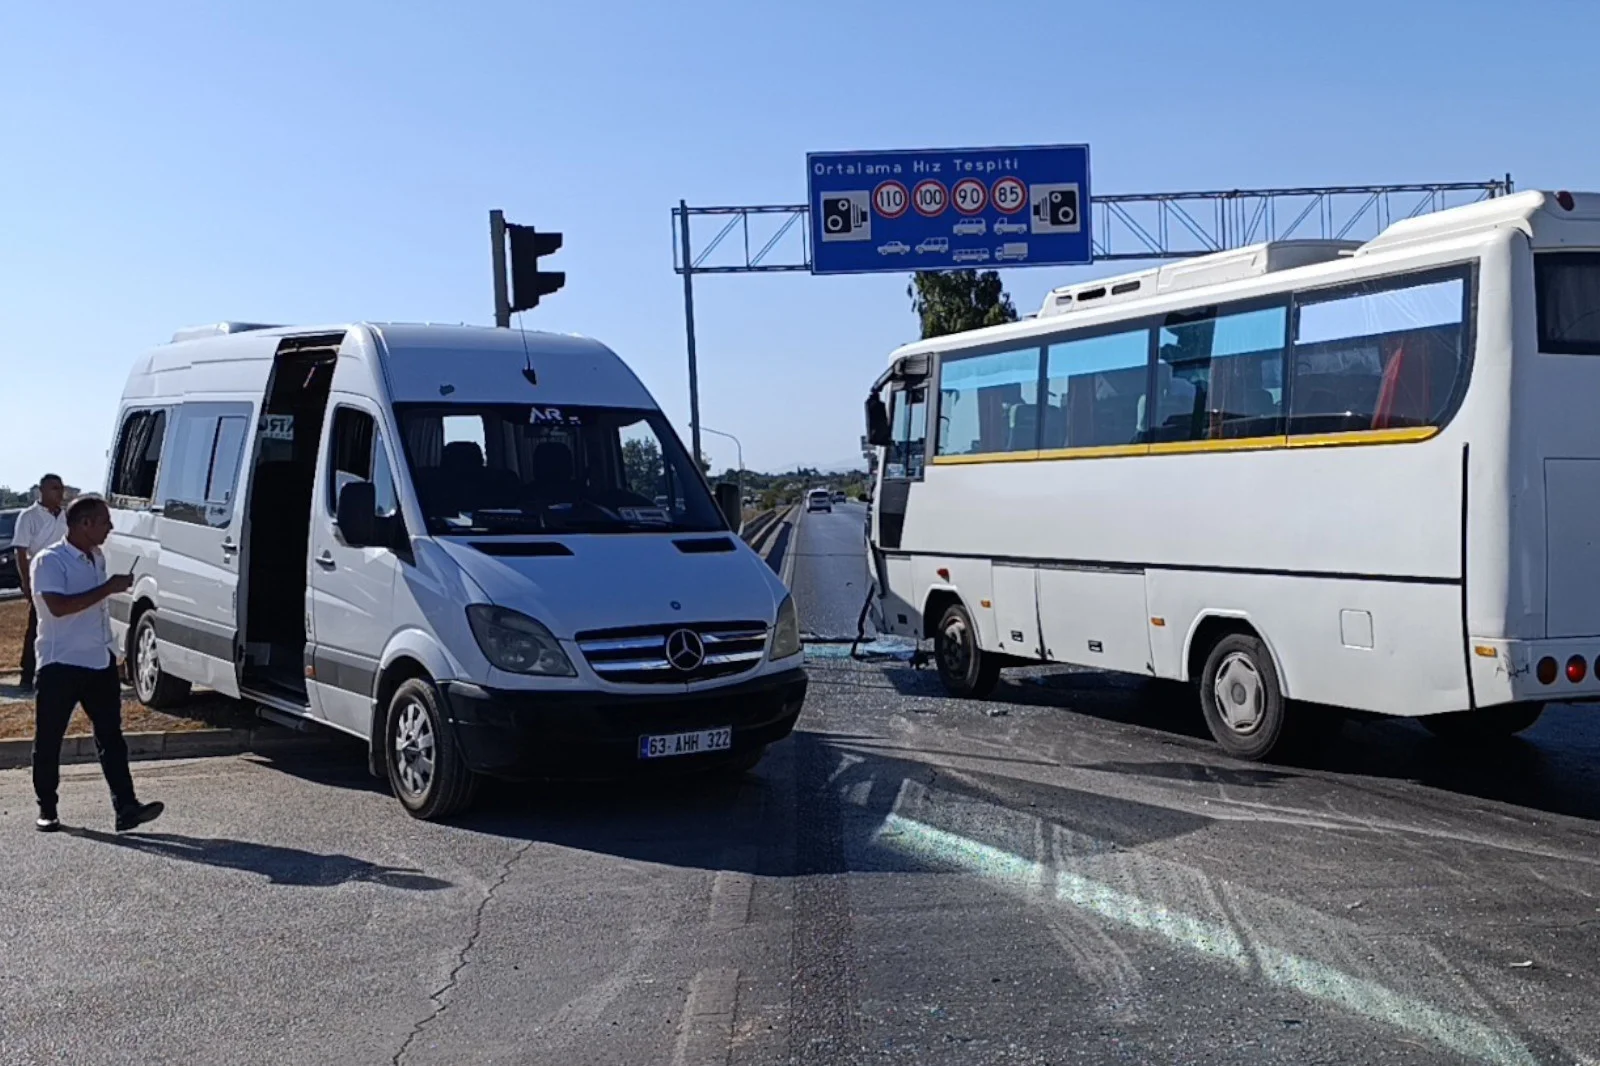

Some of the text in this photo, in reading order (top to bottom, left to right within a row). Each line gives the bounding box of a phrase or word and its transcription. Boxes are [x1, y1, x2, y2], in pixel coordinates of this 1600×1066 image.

[814, 158, 1019, 176] Ortalama Hız Tespiti
[879, 191, 903, 208] 110
[919, 190, 942, 206] 100
[958, 188, 980, 205] 90
[998, 186, 1019, 203] 85
[649, 731, 730, 755] 63 AHH 322
